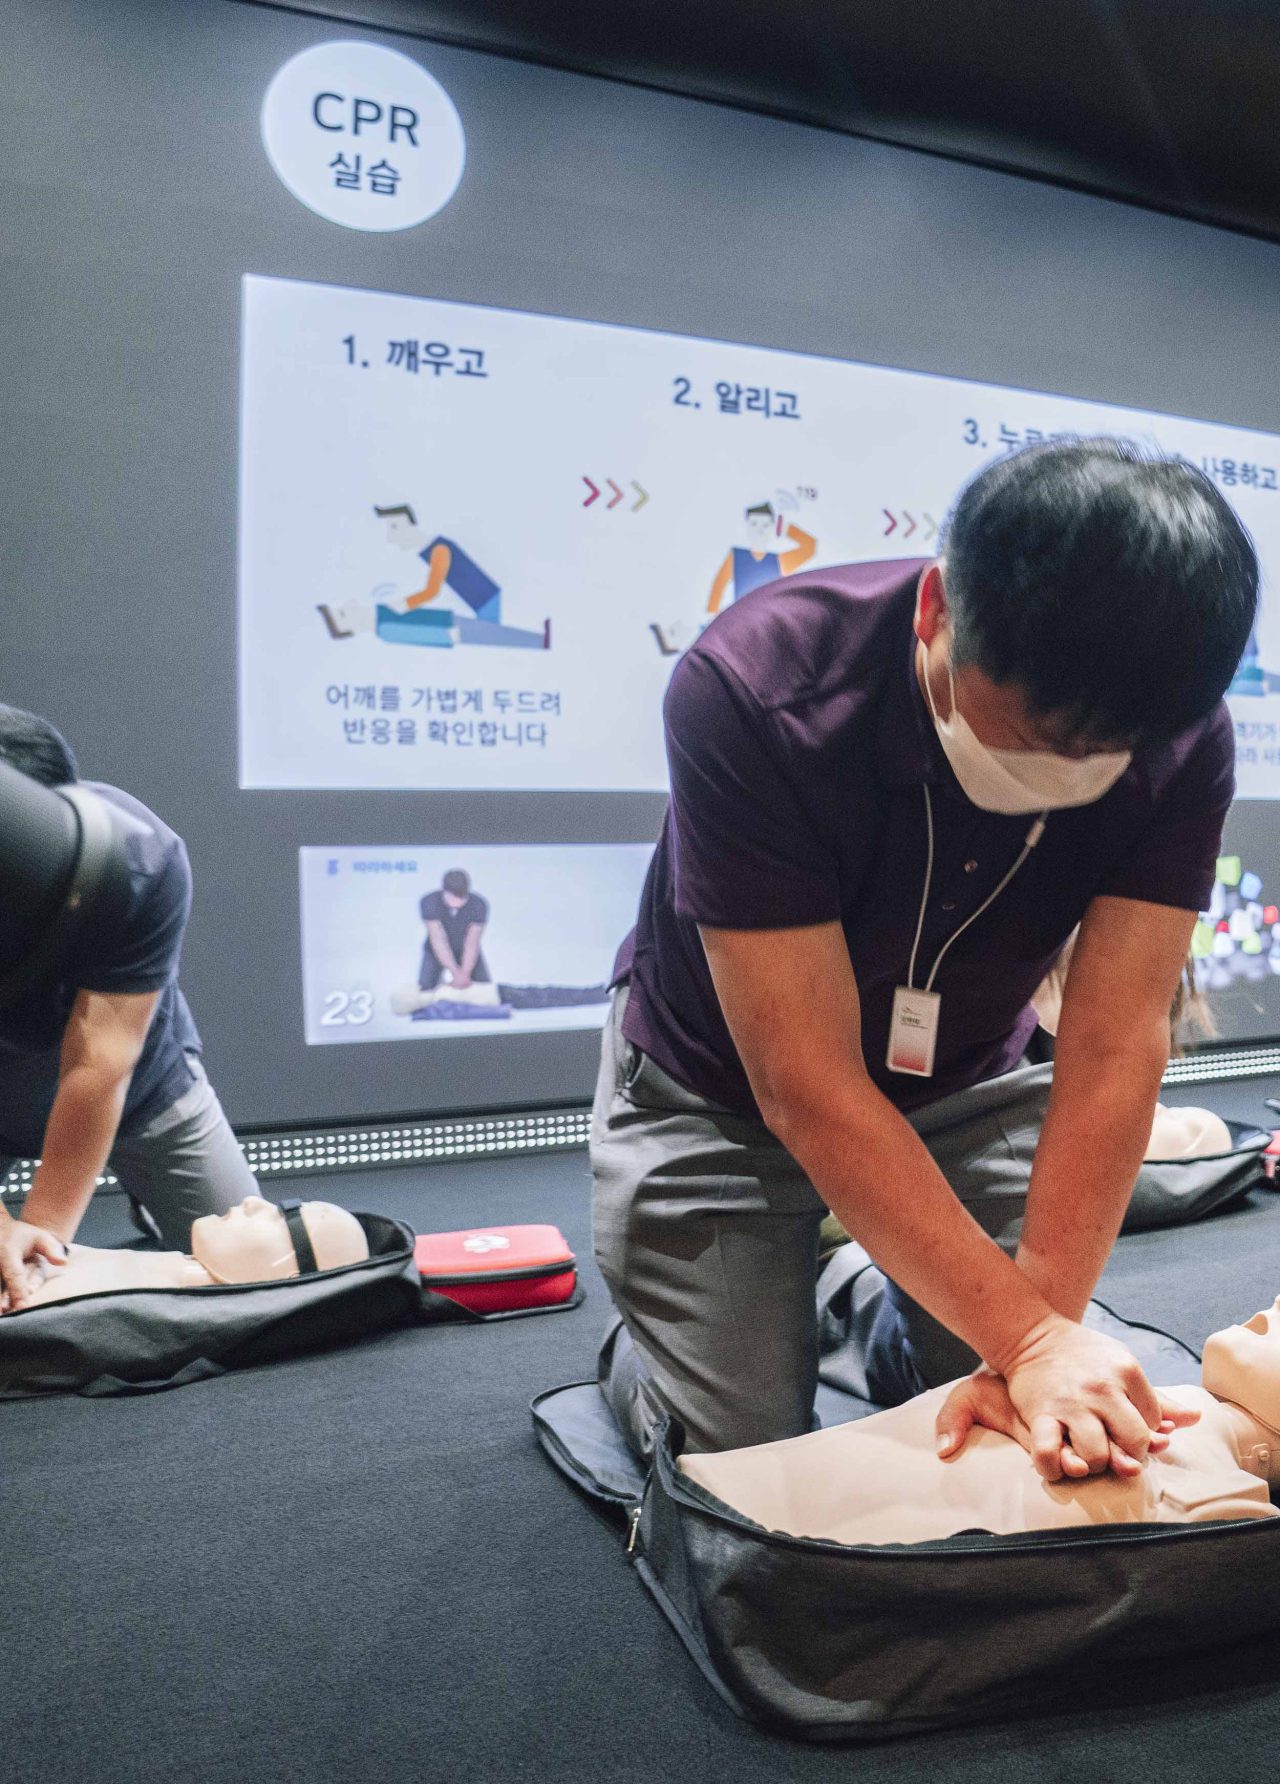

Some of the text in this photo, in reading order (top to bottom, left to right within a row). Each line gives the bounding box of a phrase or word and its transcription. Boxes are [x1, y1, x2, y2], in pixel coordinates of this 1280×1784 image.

[311, 91, 420, 148] CPR
[328, 151, 402, 196] 실습
[342, 333, 489, 379] 1. 깨우고
[673, 376, 801, 419] 2. 알리고
[962, 417, 988, 448] 3.
[325, 685, 562, 716] 어깨를 가볍게 두드려
[343, 718, 548, 748] 반응을 확인합니다
[321, 991, 374, 1027] 23
